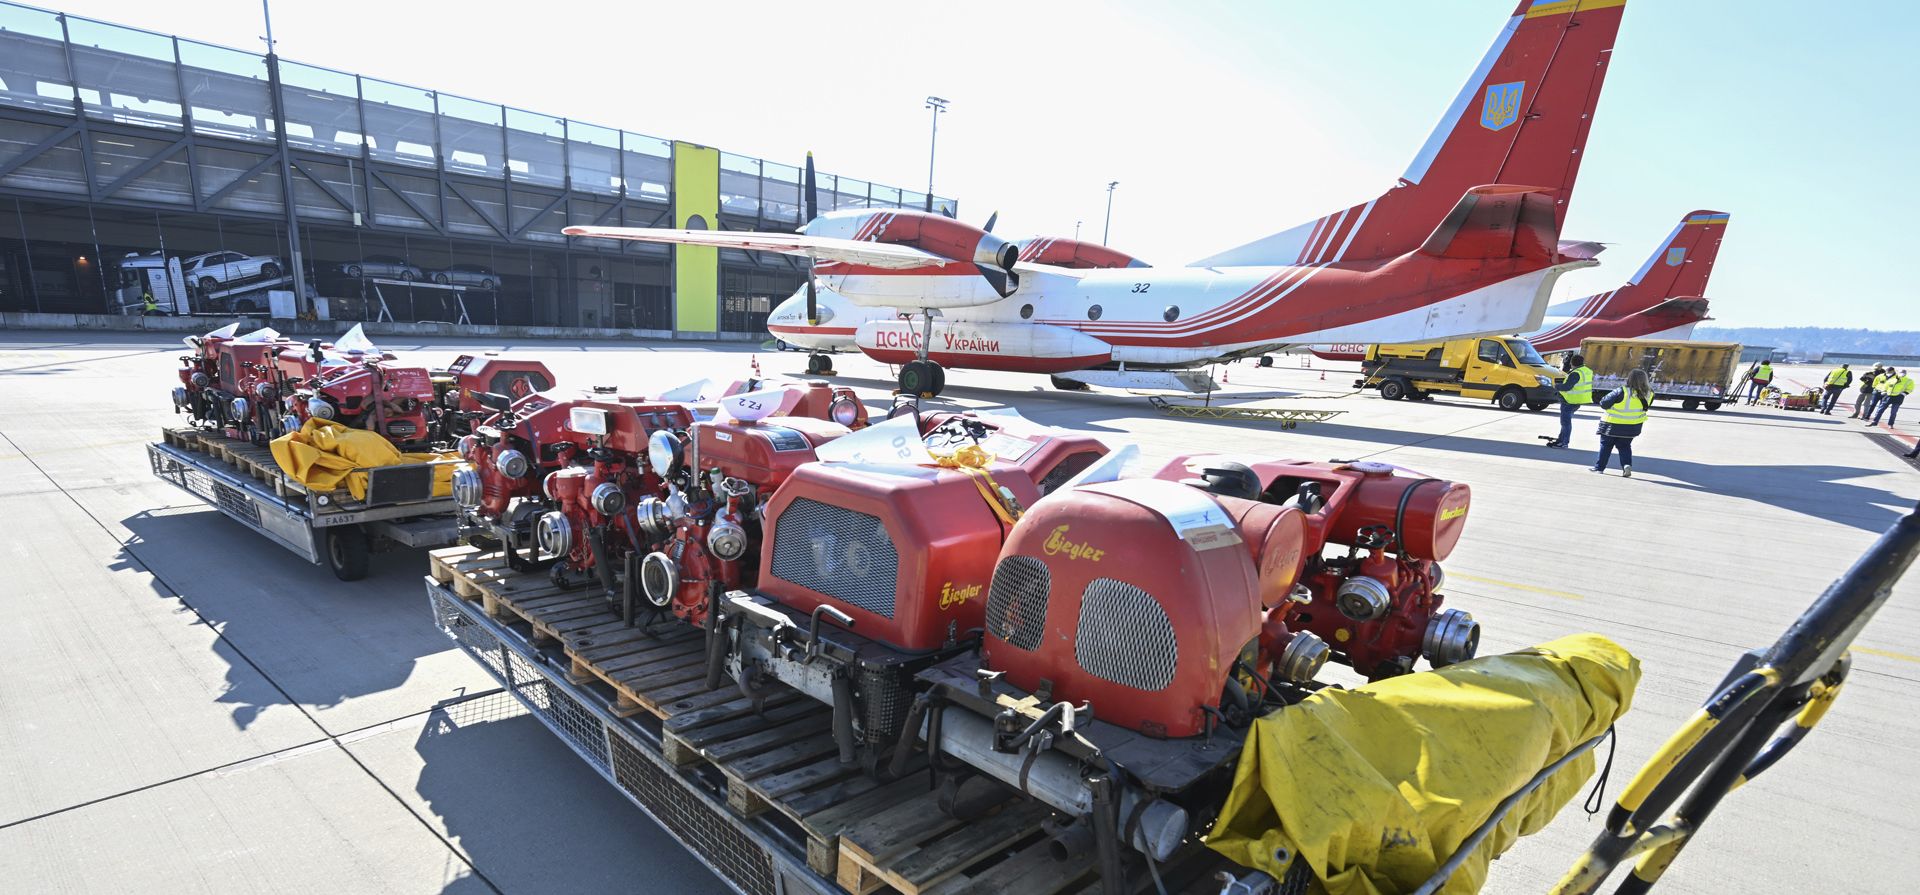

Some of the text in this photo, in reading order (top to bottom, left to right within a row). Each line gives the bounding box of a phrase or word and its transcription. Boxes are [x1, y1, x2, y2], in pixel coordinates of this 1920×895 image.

[1131, 283, 1151, 293] 32
[876, 331, 922, 348] ДСНС
[1330, 343, 1364, 353] ДСНС
[739, 398, 762, 411] FZ 2
[326, 515, 355, 525] FA637
[939, 582, 983, 610] Ziegler
